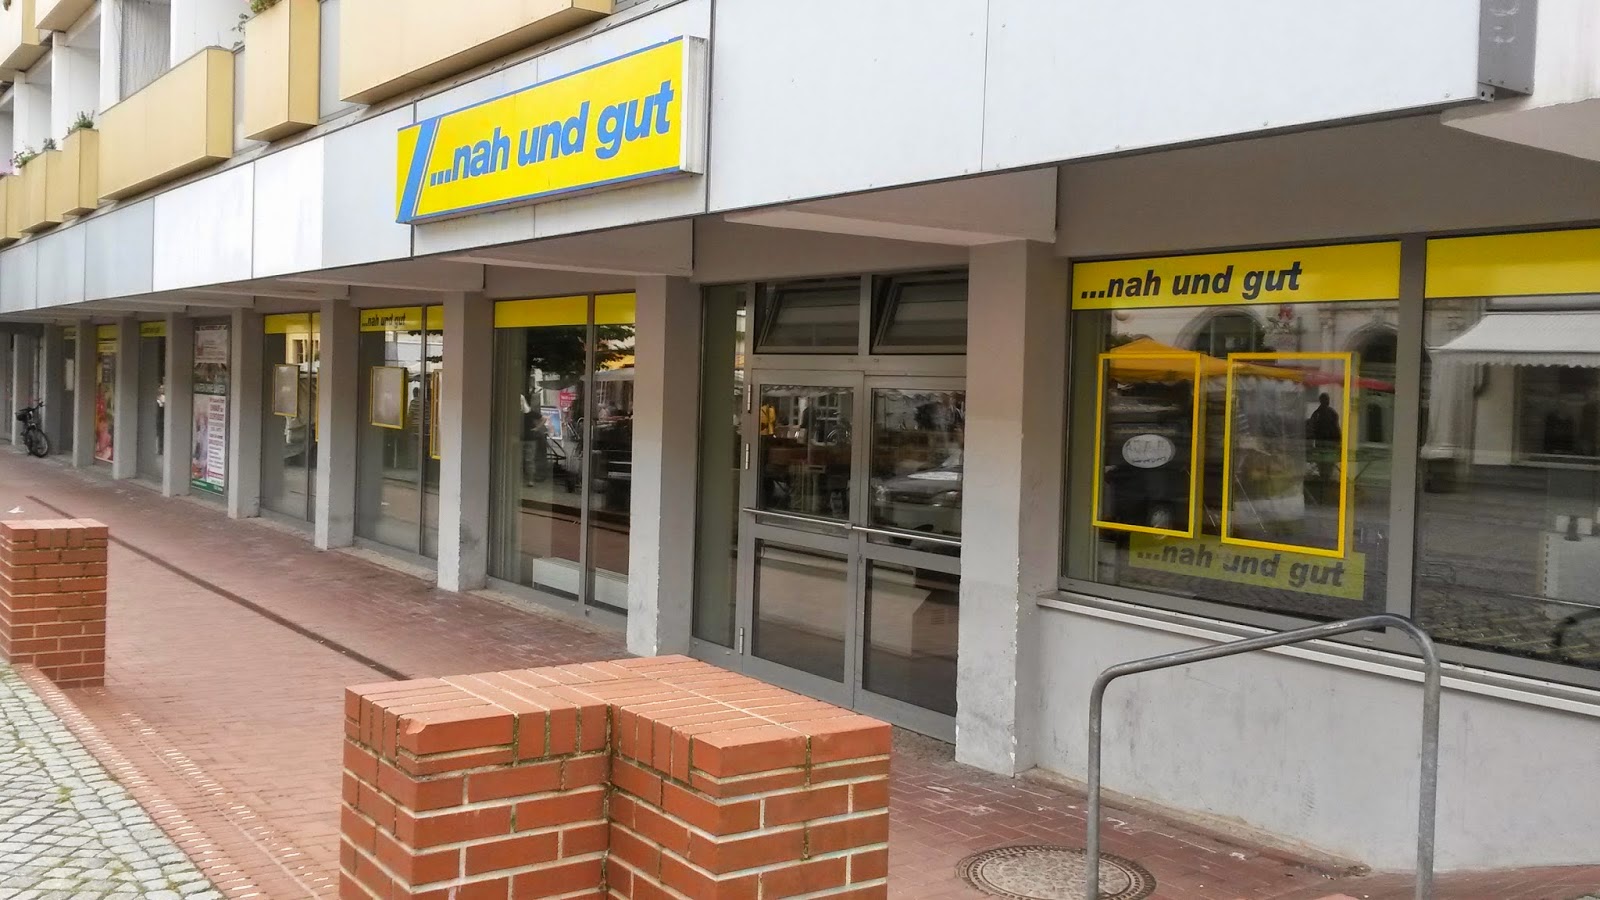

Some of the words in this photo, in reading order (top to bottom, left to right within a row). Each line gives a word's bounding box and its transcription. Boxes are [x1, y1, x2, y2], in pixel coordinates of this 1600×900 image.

[430, 127, 511, 187] ...nah
[517, 101, 590, 167] und
[596, 80, 674, 160] gut
[1080, 270, 1162, 299] ...nah
[1172, 265, 1234, 296] und
[1242, 261, 1303, 300] gut
[380, 313, 393, 326] und
[394, 313, 405, 328] gut
[1137, 542, 1213, 569] ...nah
[1222, 552, 1281, 579] und
[1289, 561, 1345, 588] gut
